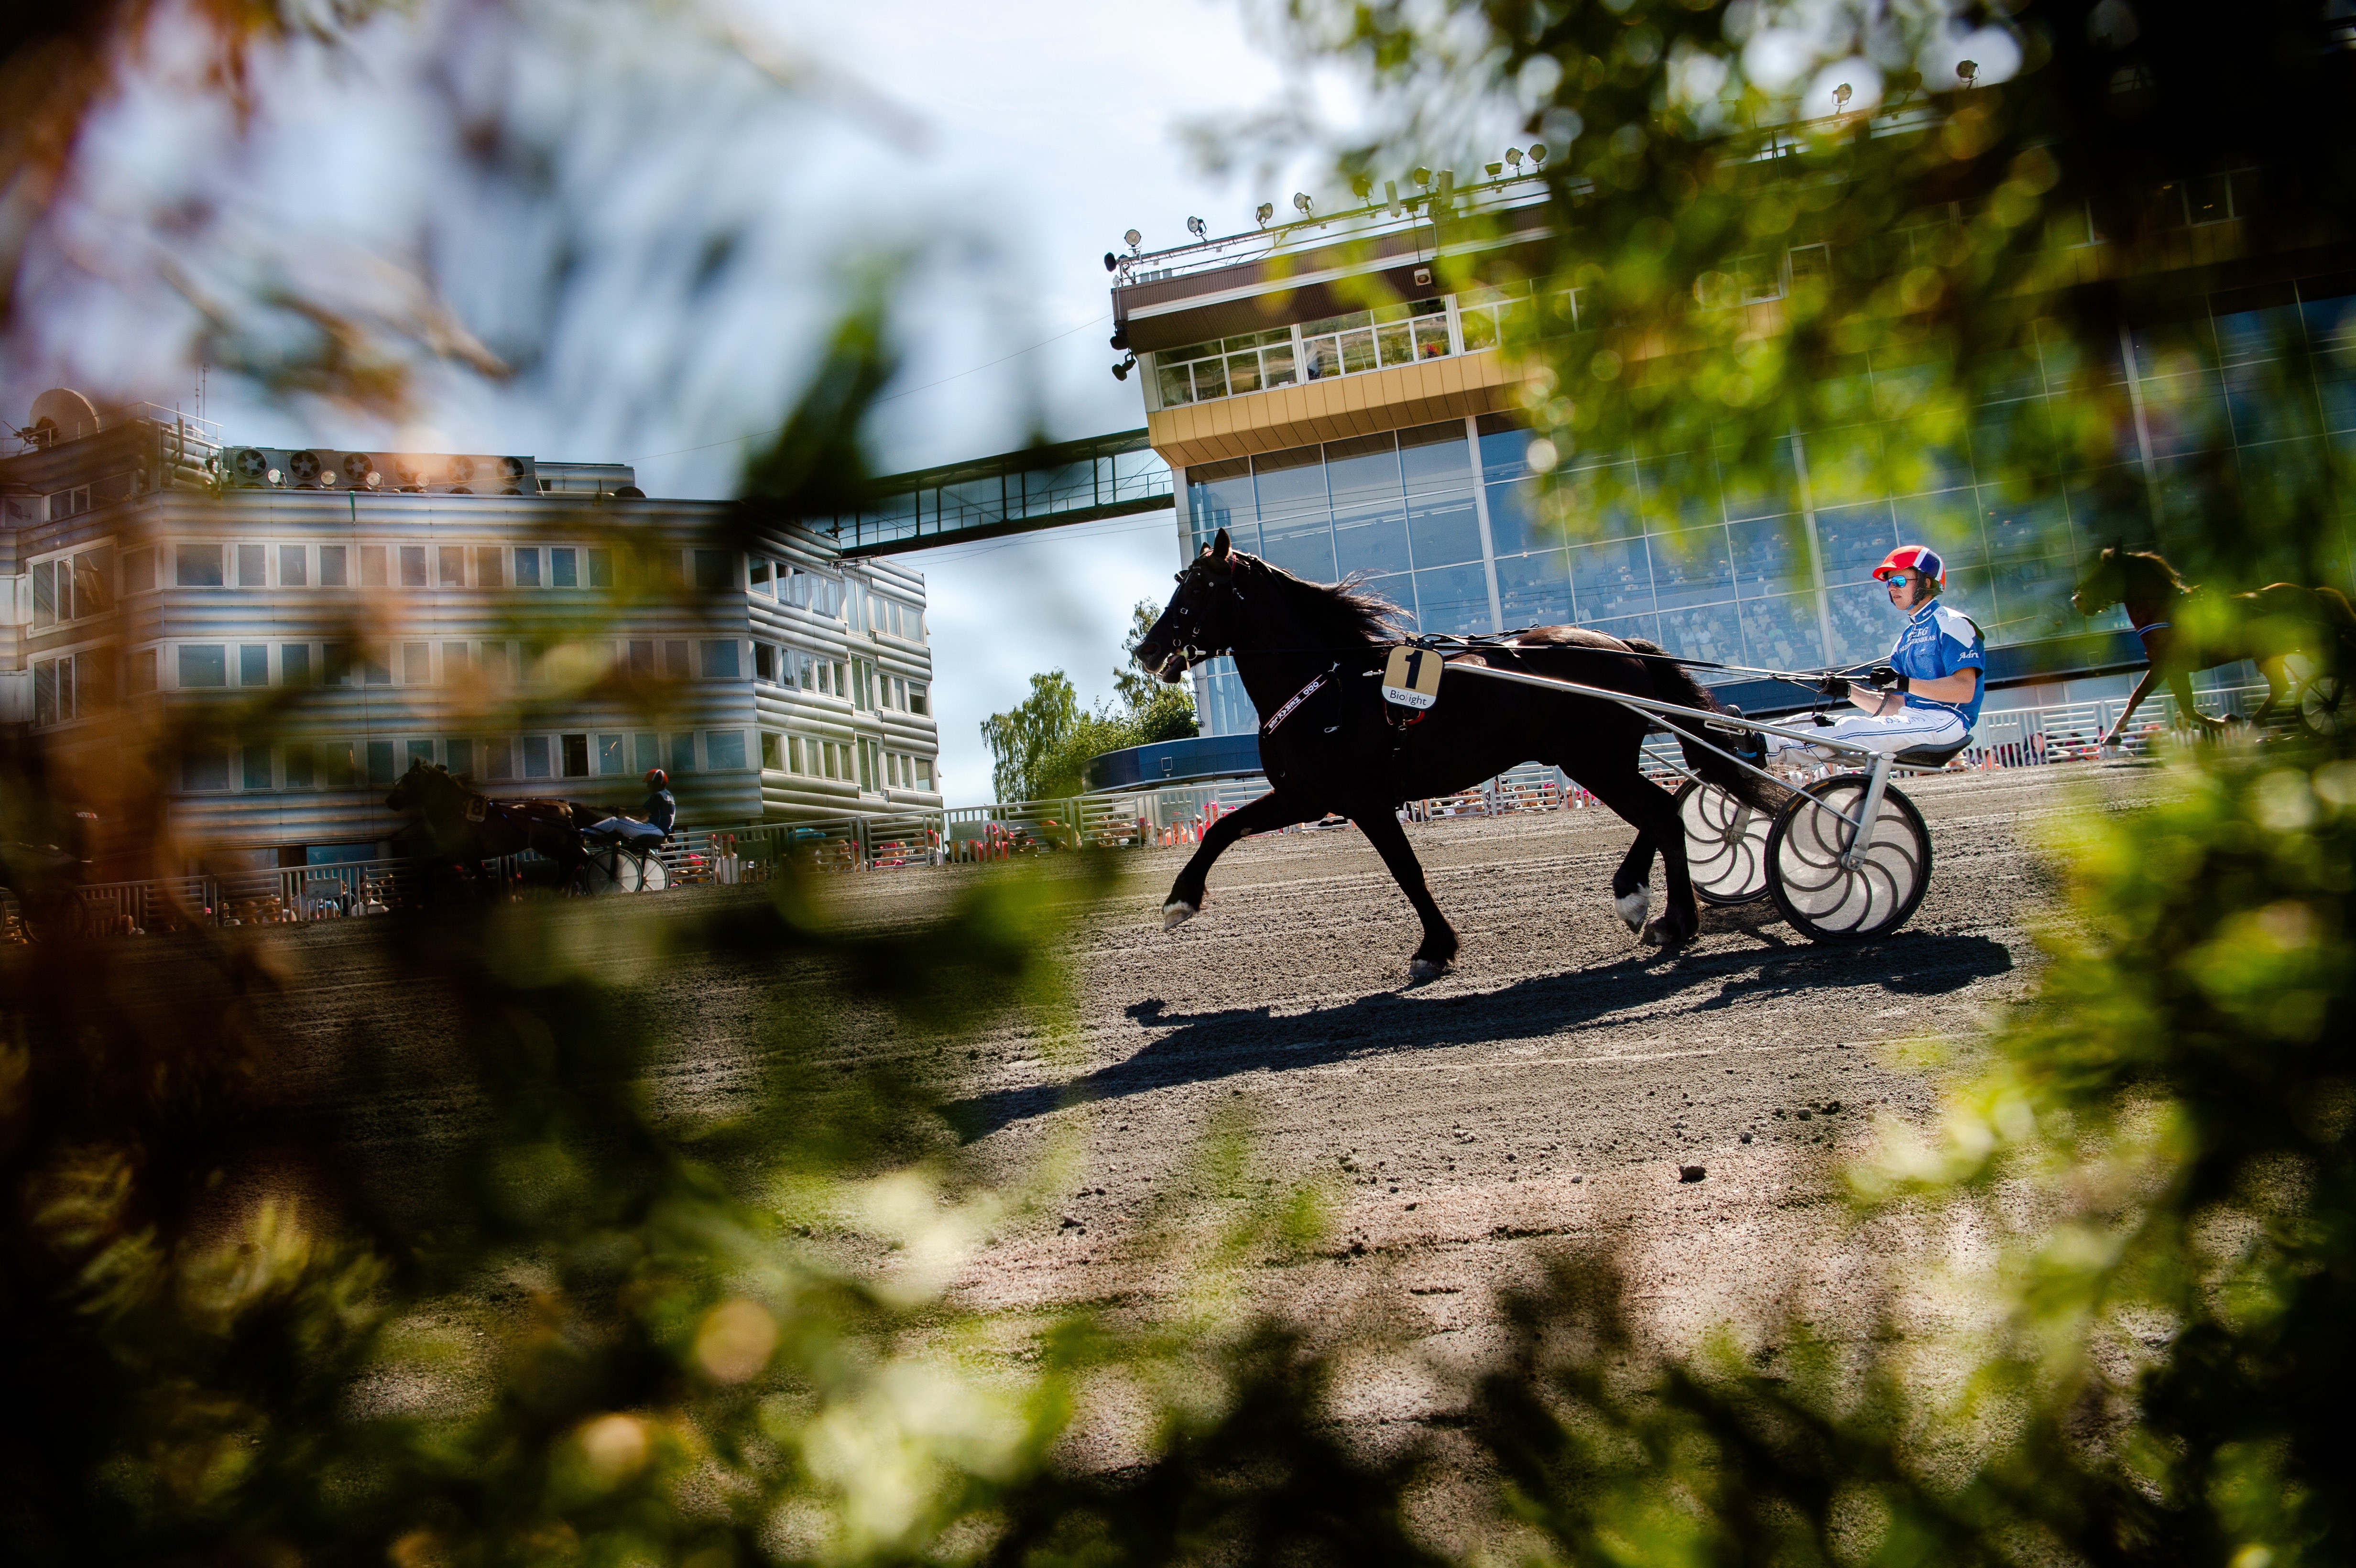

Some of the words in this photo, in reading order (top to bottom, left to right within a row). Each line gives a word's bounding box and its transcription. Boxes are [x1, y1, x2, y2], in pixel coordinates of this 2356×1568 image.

[1405, 649, 1424, 690] 1
[1303, 681, 1319, 695] ODD
[1390, 689, 1427, 706] Biolight
[1268, 696, 1301, 729] HERAKLES
